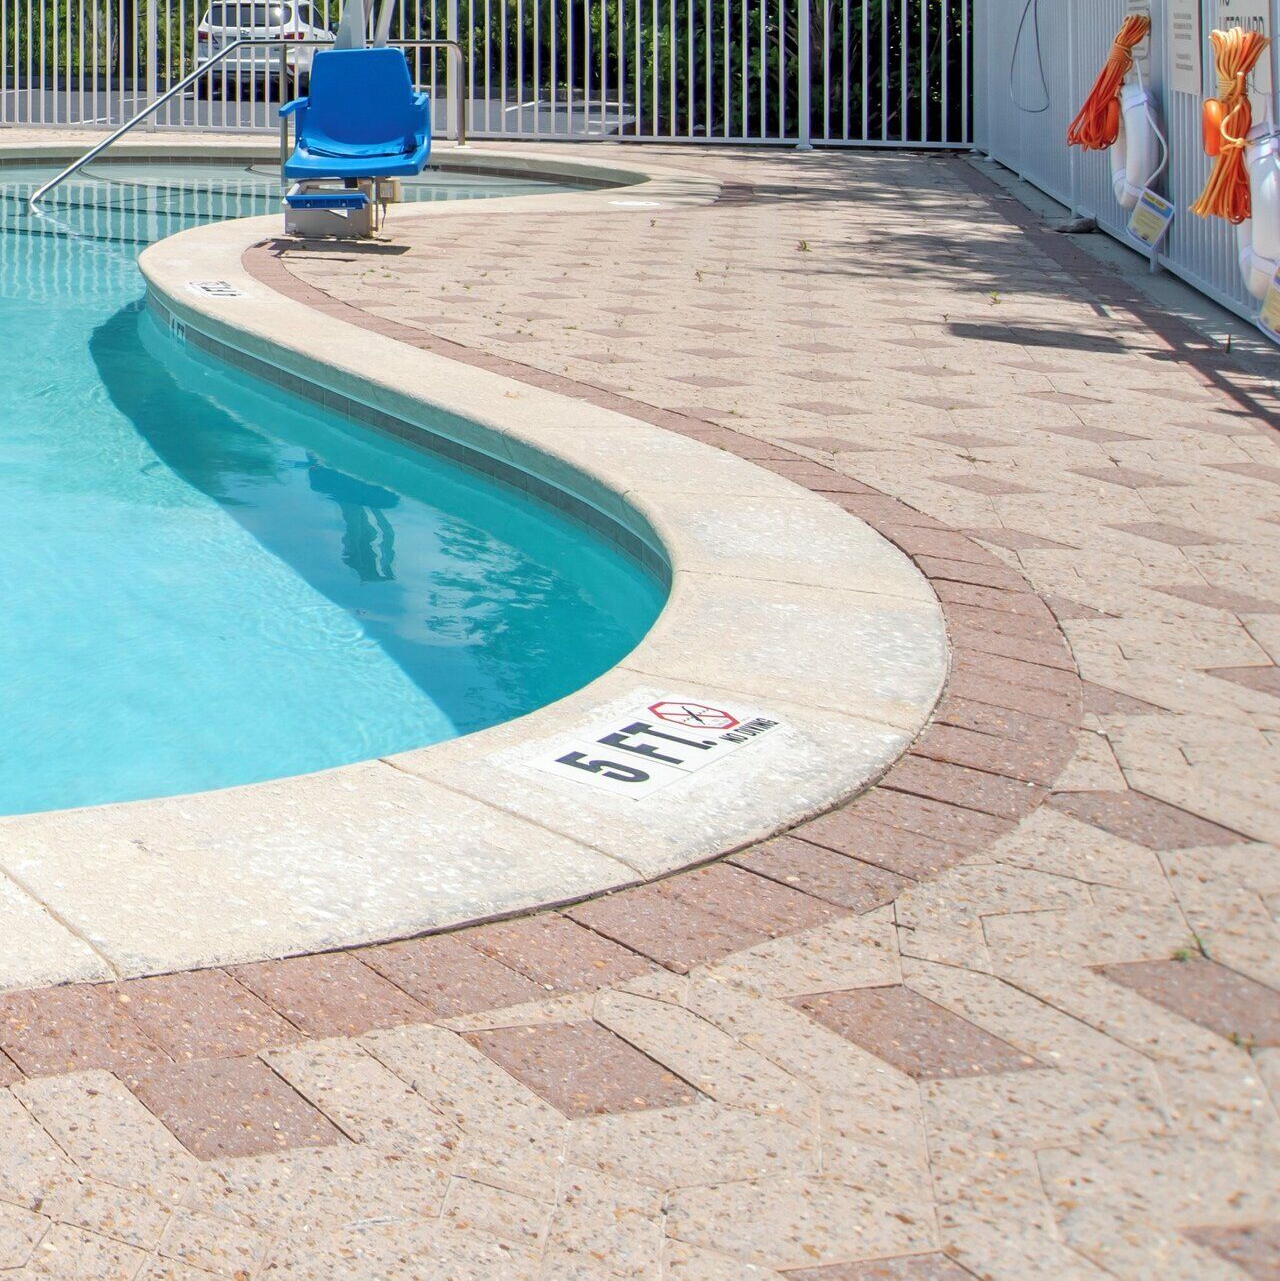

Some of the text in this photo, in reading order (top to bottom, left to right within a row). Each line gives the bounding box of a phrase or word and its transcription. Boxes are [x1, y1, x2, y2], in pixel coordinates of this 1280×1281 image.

[554, 721, 718, 783] 5 FT.
[718, 717, 781, 745] NO DIVING
